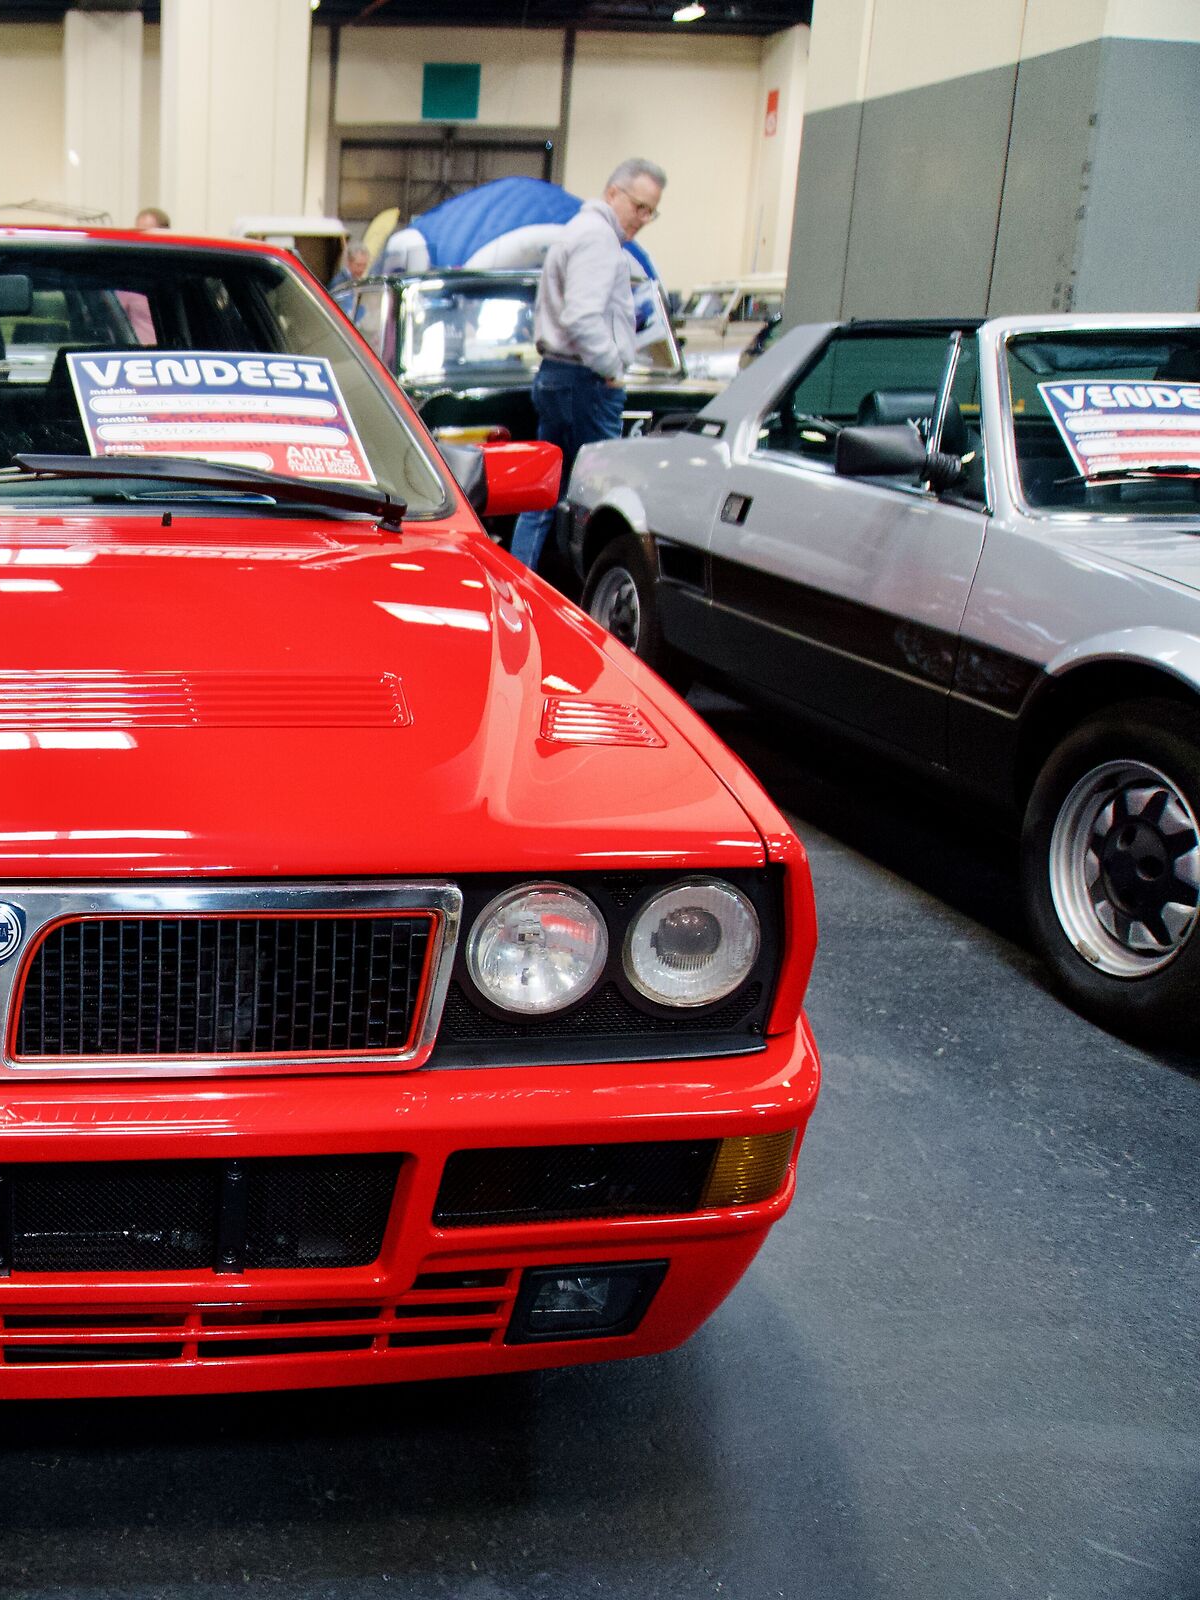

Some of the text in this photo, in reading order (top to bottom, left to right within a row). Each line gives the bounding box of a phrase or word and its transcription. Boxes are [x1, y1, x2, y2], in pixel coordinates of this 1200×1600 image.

[81, 359, 329, 392] VENDESI
[89, 387, 137, 395] modello:
[96, 416, 149, 424] contatto:
[104, 444, 145, 454] prezzo:
[287, 445, 355, 464] AMTS
